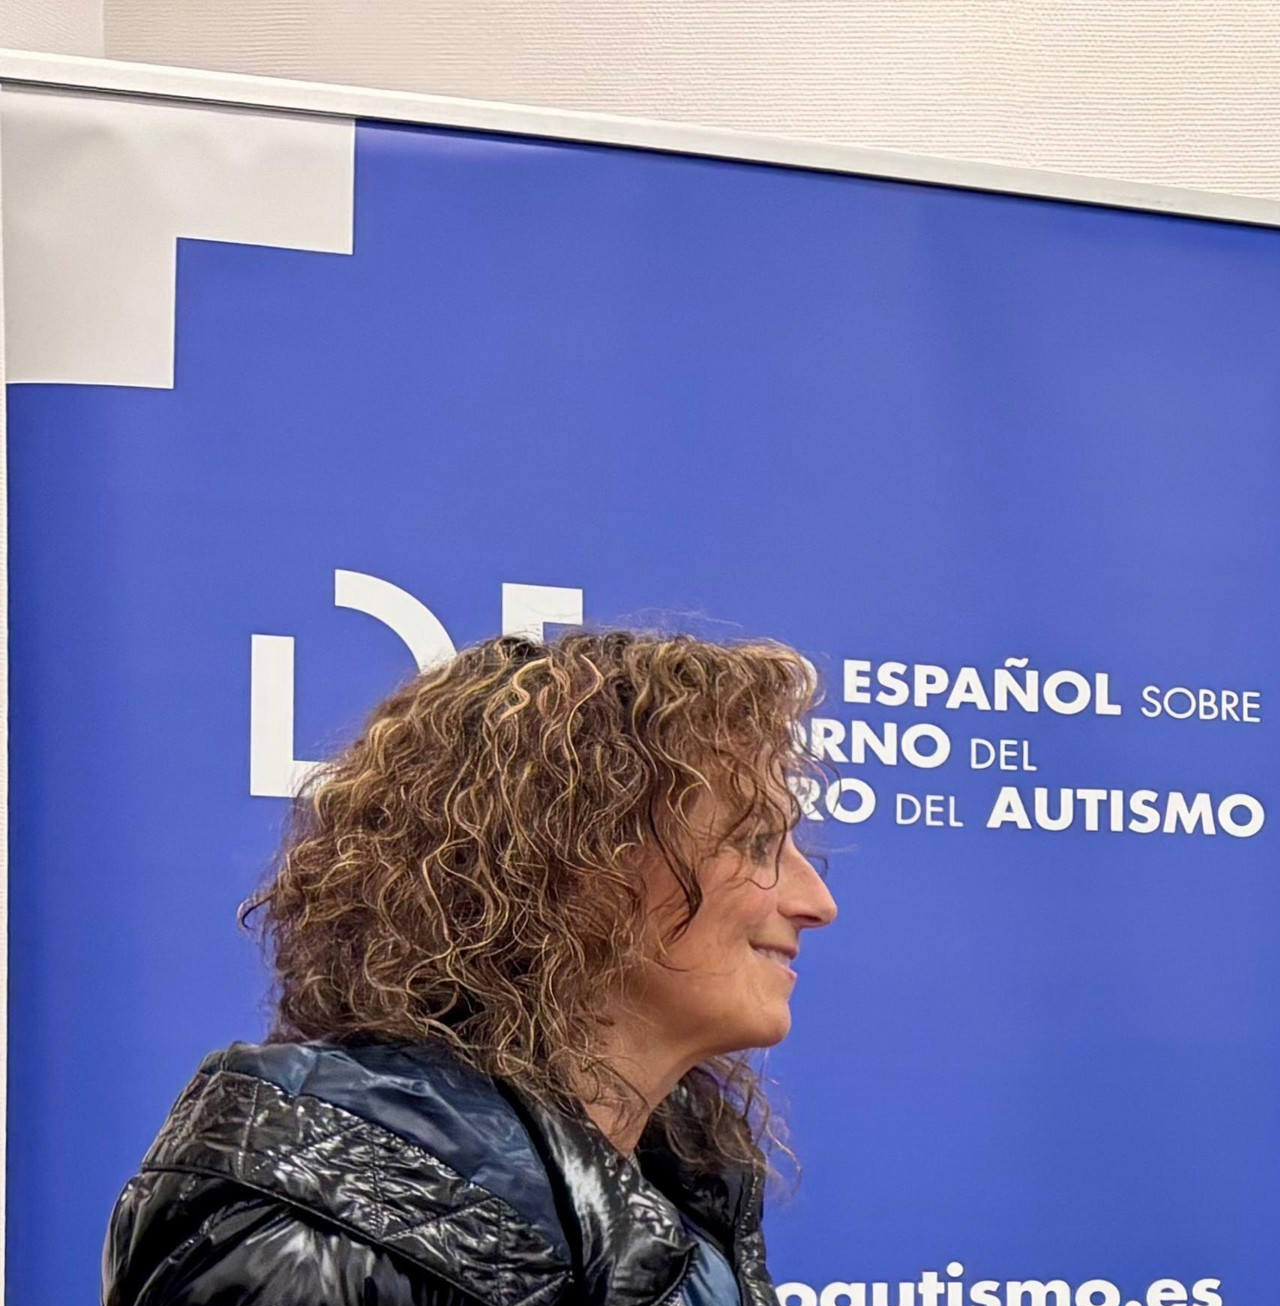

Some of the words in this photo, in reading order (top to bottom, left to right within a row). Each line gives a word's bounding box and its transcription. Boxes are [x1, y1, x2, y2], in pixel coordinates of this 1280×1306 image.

[844, 658, 1121, 717] ESPAÑOL
[1141, 685, 1261, 723] SOBRE
[970, 738, 1037, 771] DEL
[896, 793, 964, 827] DEL
[986, 786, 1265, 838] AUTISMO
